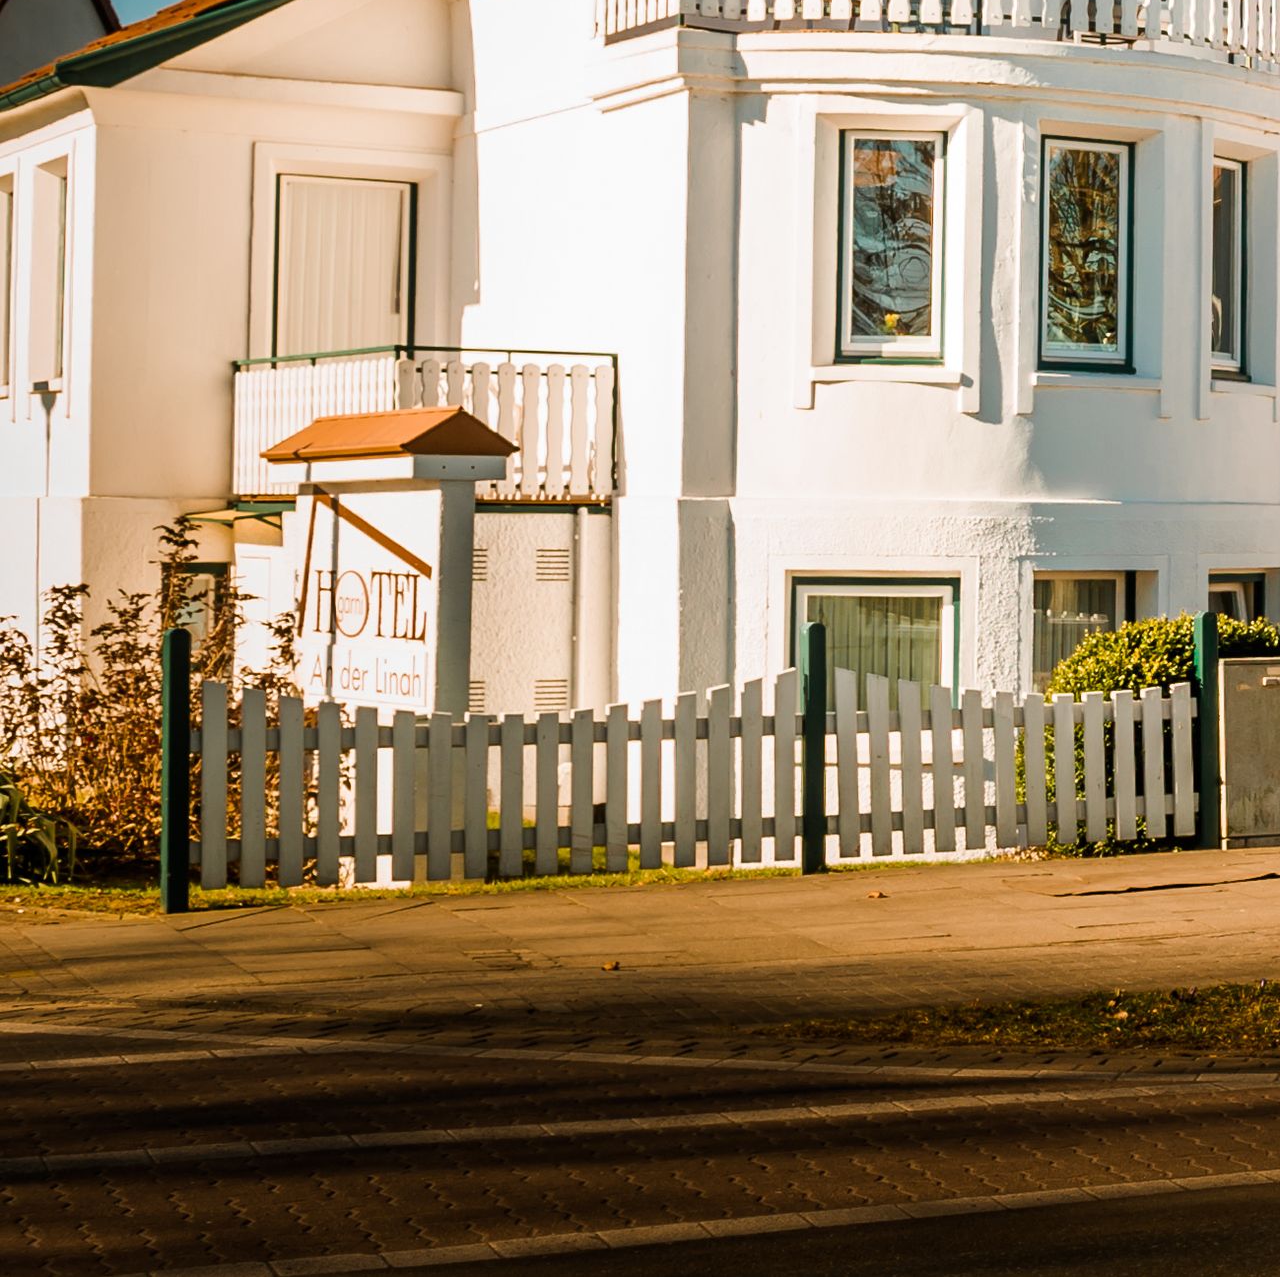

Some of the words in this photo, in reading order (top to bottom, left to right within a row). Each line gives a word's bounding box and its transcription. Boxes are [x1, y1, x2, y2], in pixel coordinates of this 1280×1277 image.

[313, 569, 427, 643] HOTEL
[341, 649, 368, 691] der
[375, 654, 421, 699] Linah
